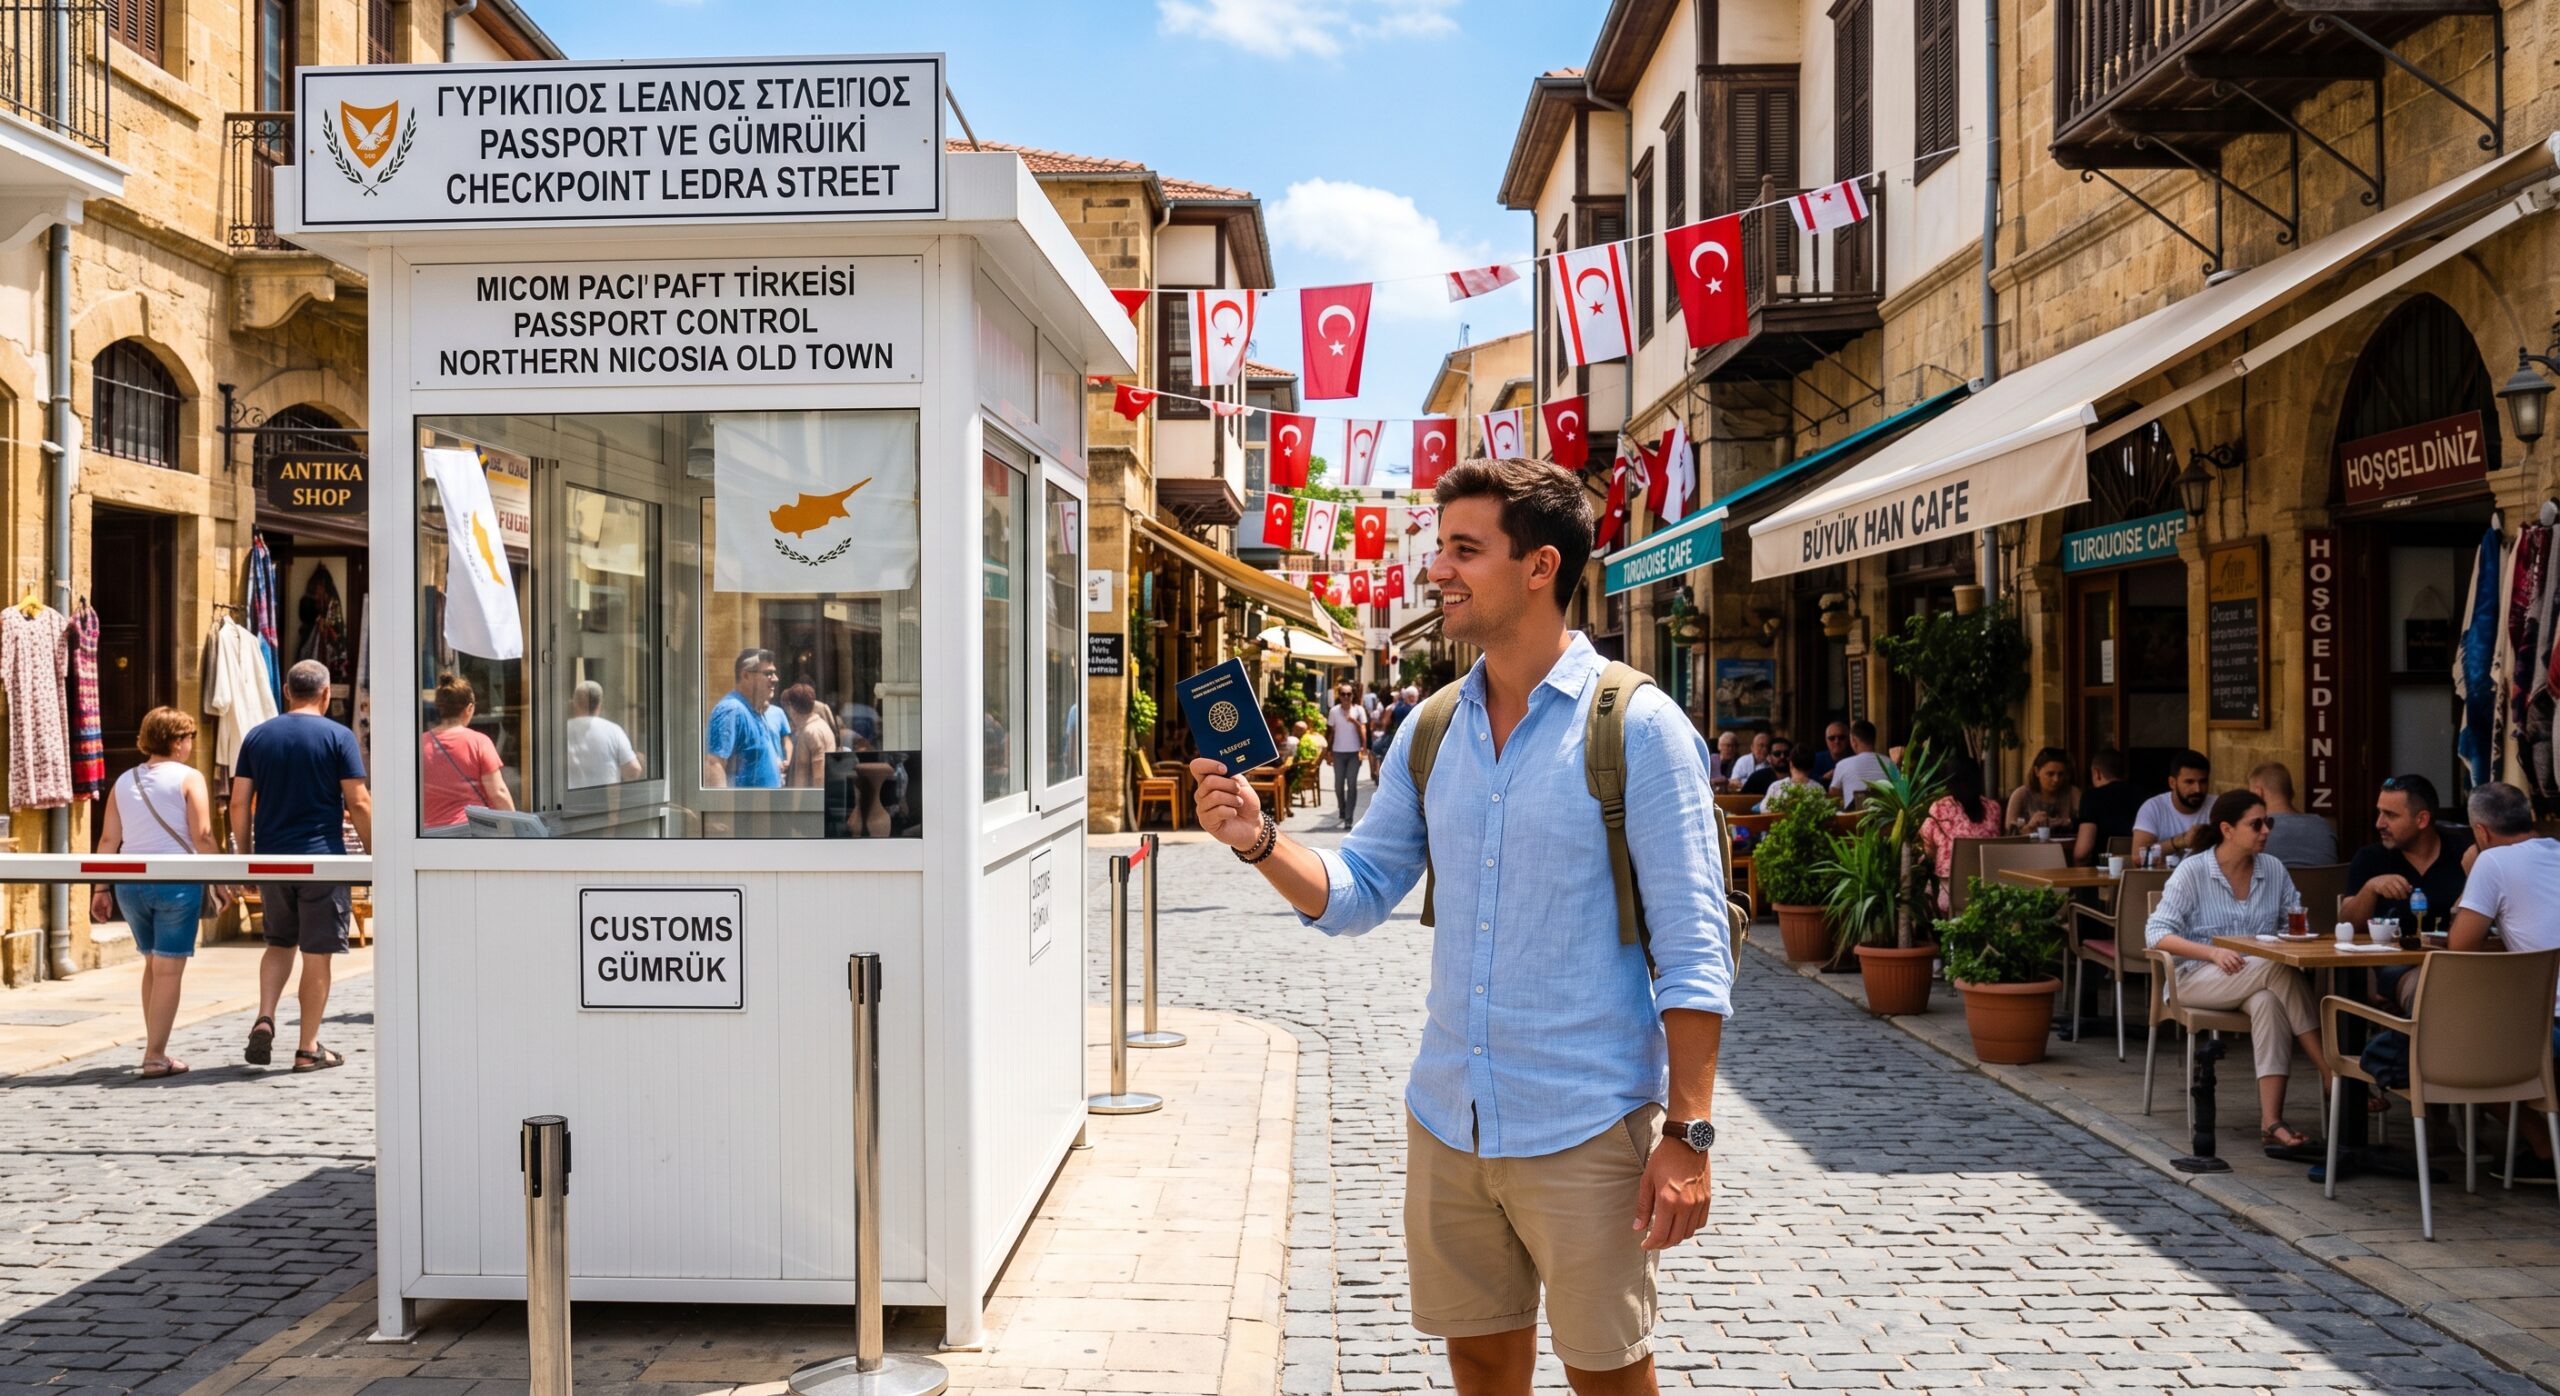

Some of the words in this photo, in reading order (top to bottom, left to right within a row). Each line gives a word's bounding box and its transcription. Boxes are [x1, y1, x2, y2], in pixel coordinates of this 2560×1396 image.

[480, 125, 648, 160] PASSPORT
[657, 125, 698, 156] VE
[446, 170, 651, 205] CHECKPOINT
[661, 167, 769, 200] LEDRA
[776, 164, 901, 199] STREET
[477, 275, 569, 302] MICOM
[733, 264, 856, 298] TİRKEİSİ
[514, 309, 668, 338] PASSPORT
[676, 307, 818, 336] CONTROL
[440, 347, 599, 376] NORTHERN
[609, 345, 729, 373] NICOSIA
[736, 344, 797, 371] OLD
[805, 342, 893, 370] TOWN
[280, 462, 363, 481] ANTIKA
[2346, 425, 2481, 491] HOŞGELDİNİZ
[292, 487, 351, 506] SHOP
[1802, 512, 1859, 563] BÜYÜK
[1864, 500, 1905, 547] HAN
[1911, 479, 1970, 536] CAFE
[1668, 538, 1693, 571] CAFE
[2071, 526, 2143, 564] TURQUOISE
[2309, 539, 2333, 808] HOŞGELDİNİZ
[590, 916, 733, 942] CUSTOMS
[597, 950, 727, 983] GÜMRÜK
